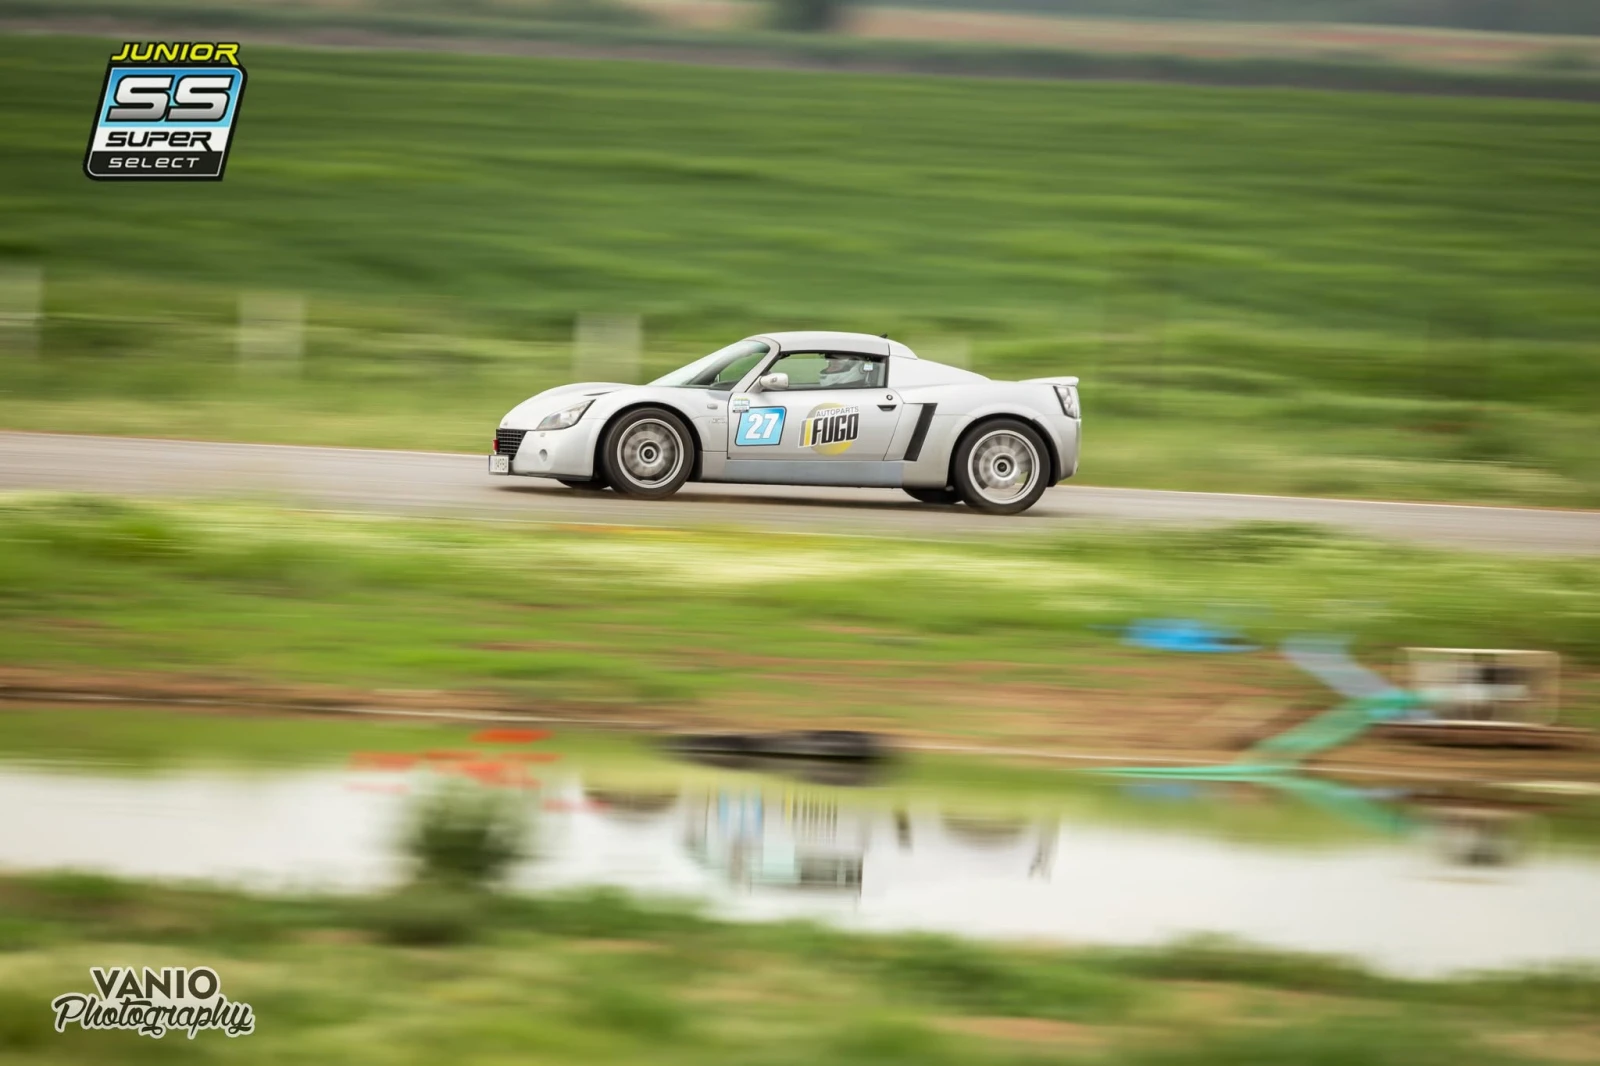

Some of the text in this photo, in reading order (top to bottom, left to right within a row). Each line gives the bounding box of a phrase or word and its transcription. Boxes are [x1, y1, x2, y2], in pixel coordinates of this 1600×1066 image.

[816, 405, 860, 417] AUTOPARTS
[745, 412, 780, 440] 27
[811, 413, 859, 446] FUGO
